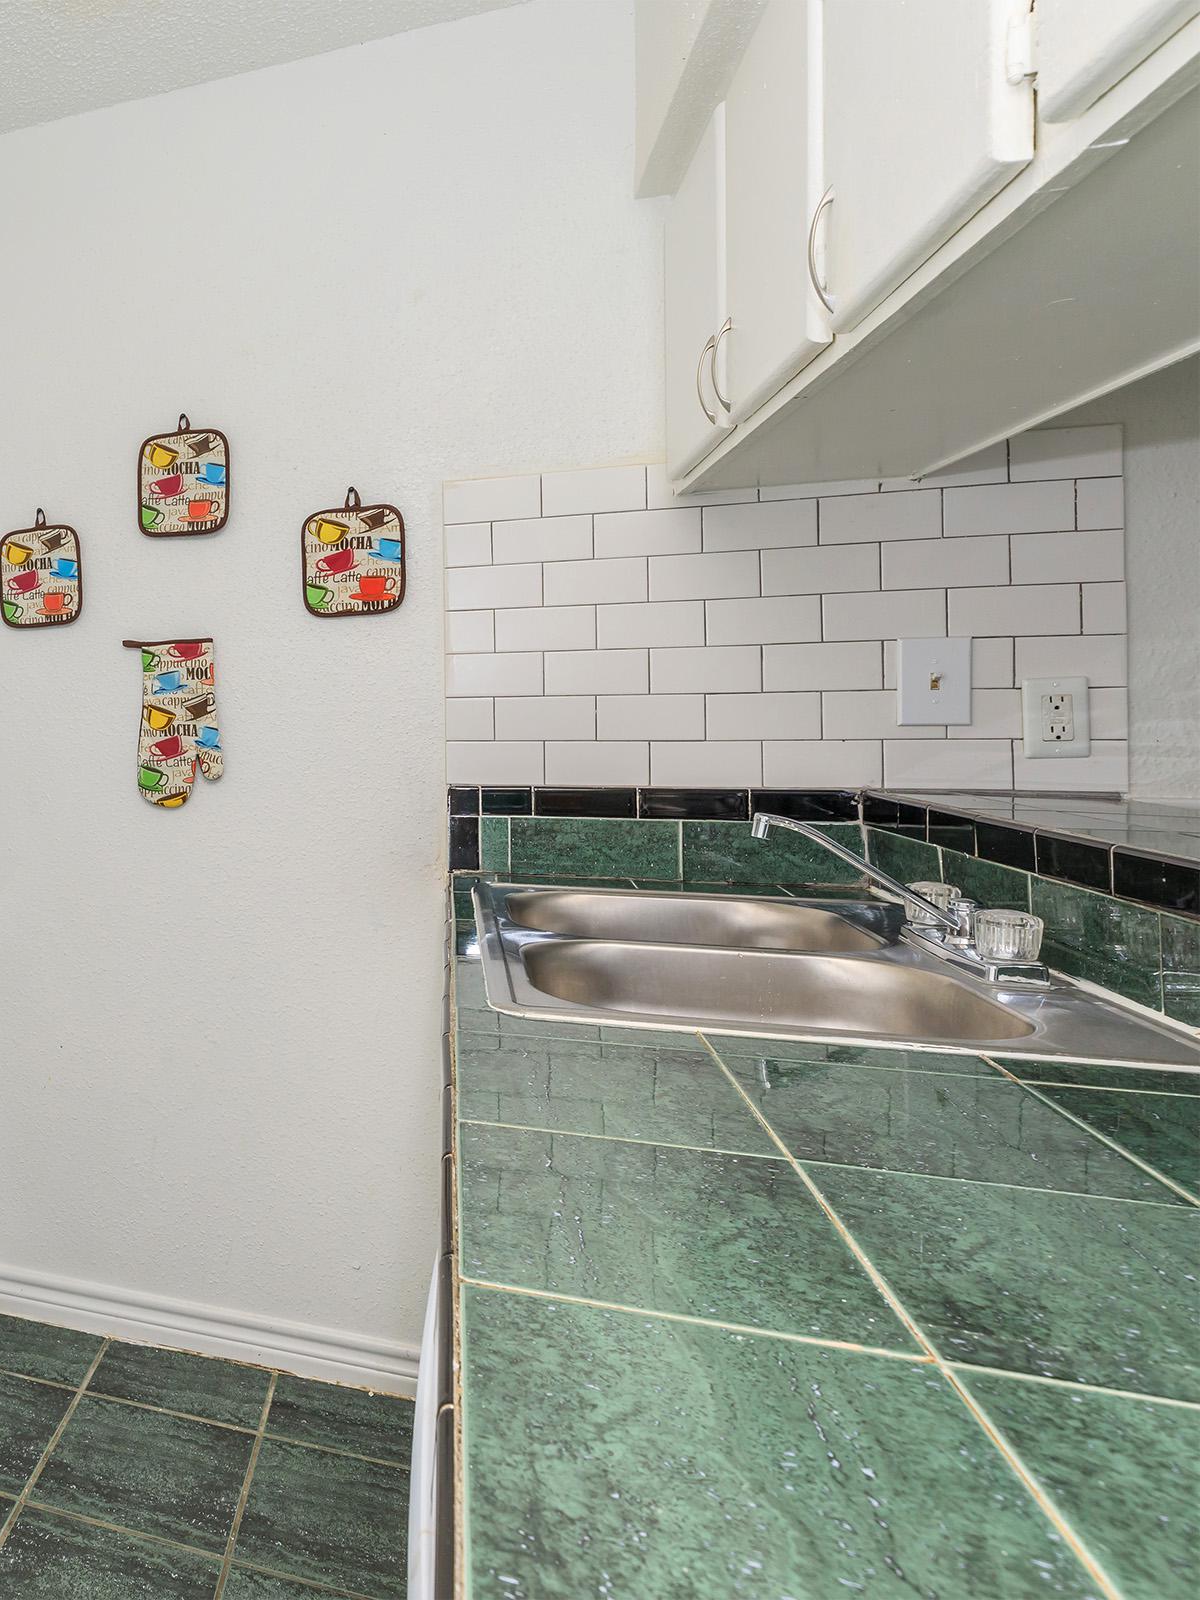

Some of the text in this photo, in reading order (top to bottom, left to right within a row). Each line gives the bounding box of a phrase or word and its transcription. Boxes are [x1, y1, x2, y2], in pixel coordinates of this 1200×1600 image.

[162, 462, 200, 475] MOCHA
[330, 536, 373, 551] MOCHA
[19, 557, 53, 571] MOCHA
[160, 724, 198, 737] MOCHA
